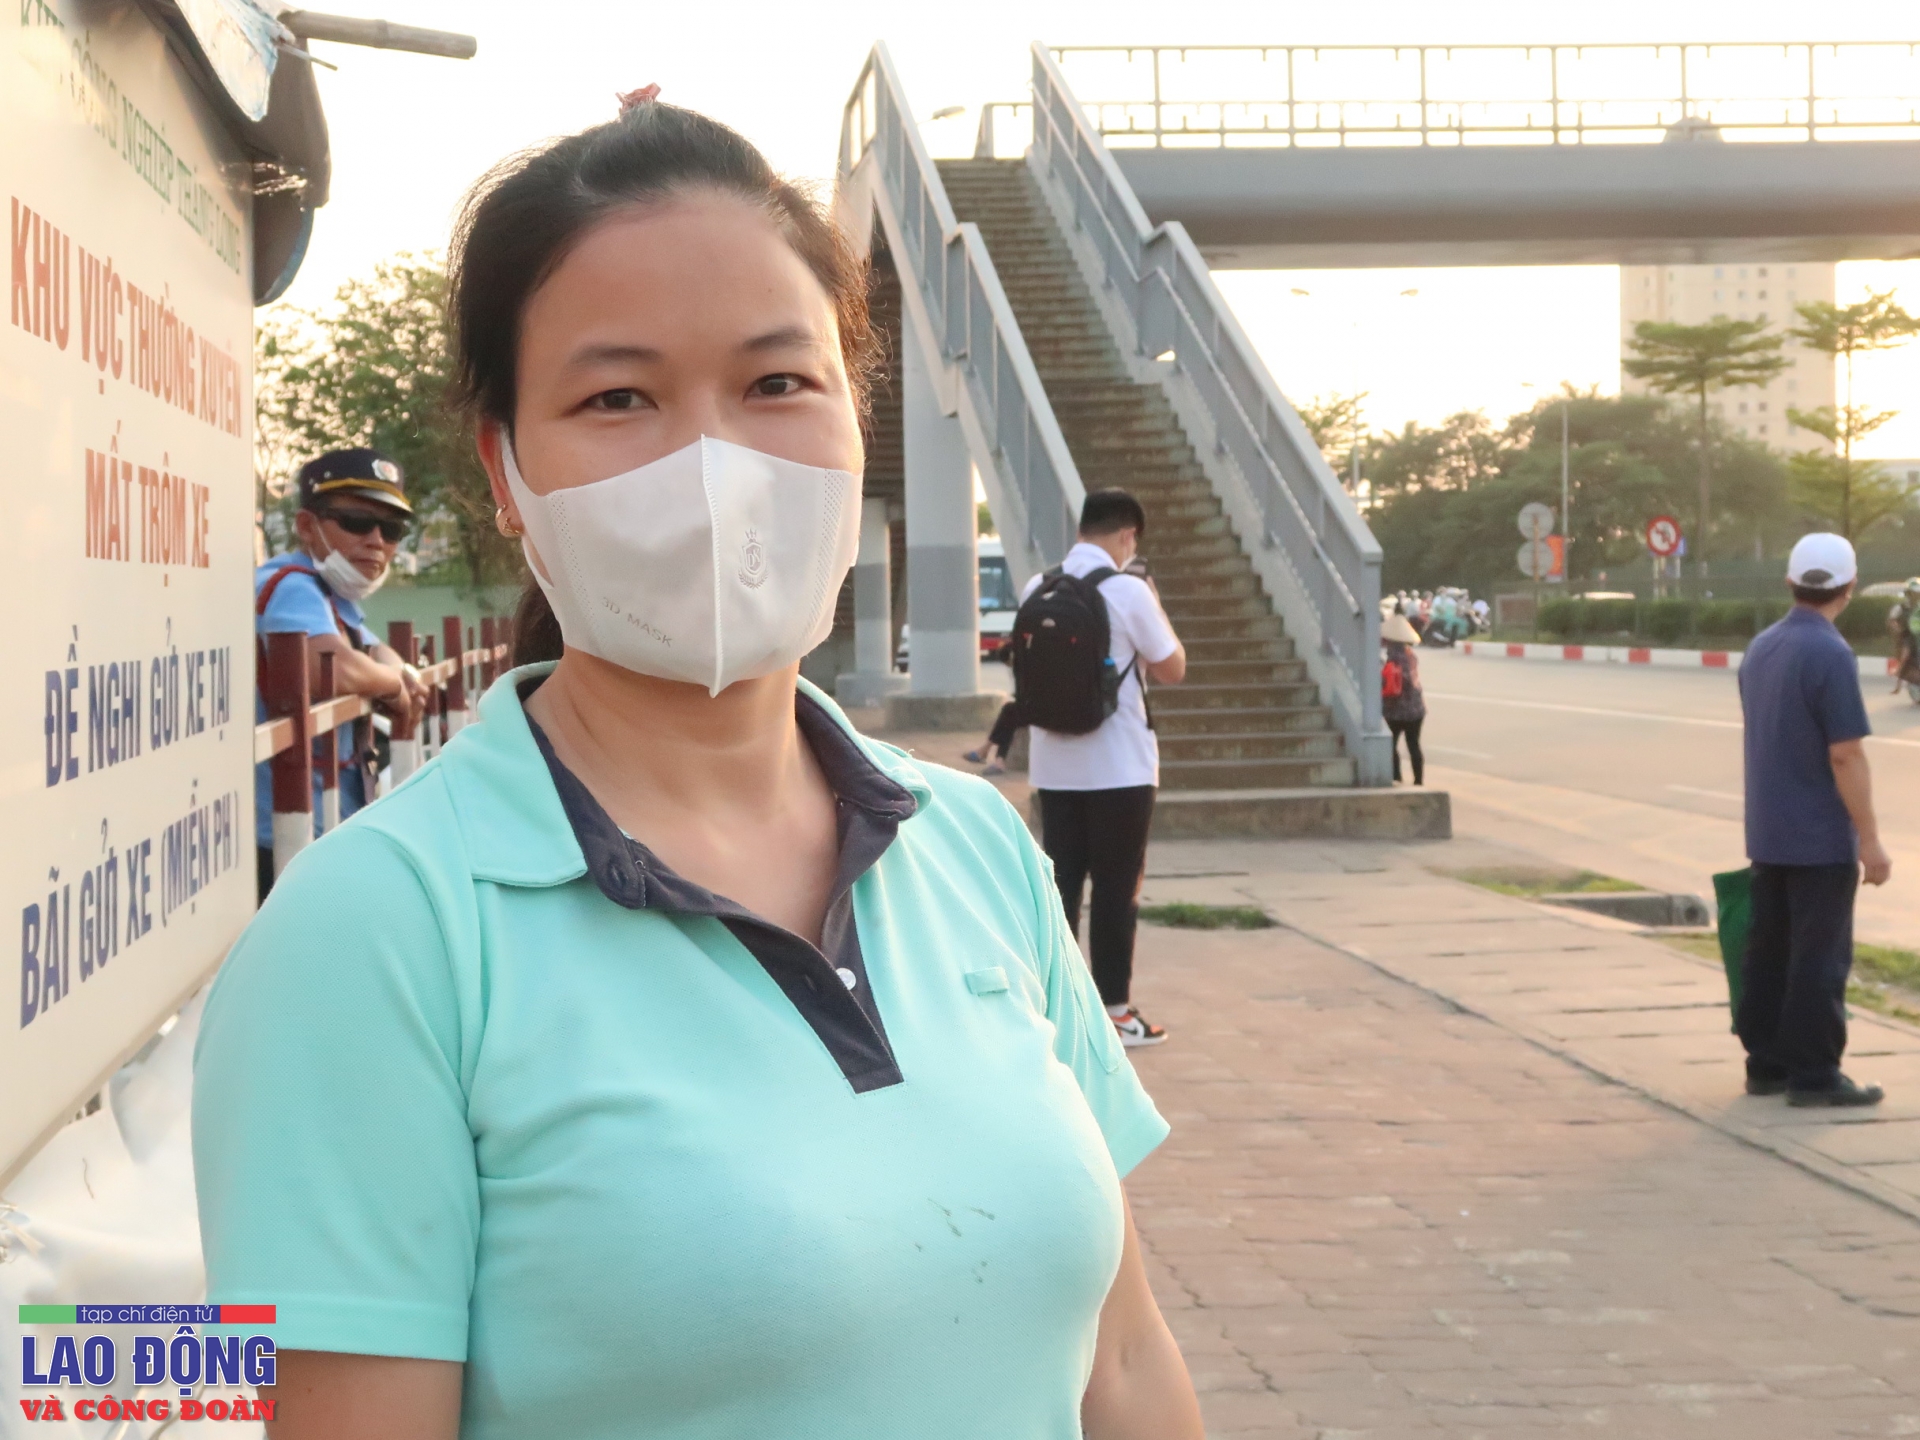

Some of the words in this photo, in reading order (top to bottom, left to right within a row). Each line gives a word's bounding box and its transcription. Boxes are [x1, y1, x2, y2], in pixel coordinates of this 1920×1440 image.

[11, 195, 70, 351] KHU
[78, 244, 123, 395] VỰC
[127, 281, 195, 416] THƯỜNG
[199, 335, 241, 438] XUYÊN
[85, 419, 132, 562] MẤT
[138, 451, 186, 587] TRỘM
[191, 482, 209, 569] XE
[44, 624, 79, 788] ĐỀ
[150, 616, 179, 751] GỬI
[185, 651, 204, 738] XE
[209, 646, 231, 741] TẠI
[627, 613, 673, 648] MASK
[20, 866, 70, 1030] BÃI
[79, 817, 118, 983] GỬI
[126, 838, 152, 947] XE
